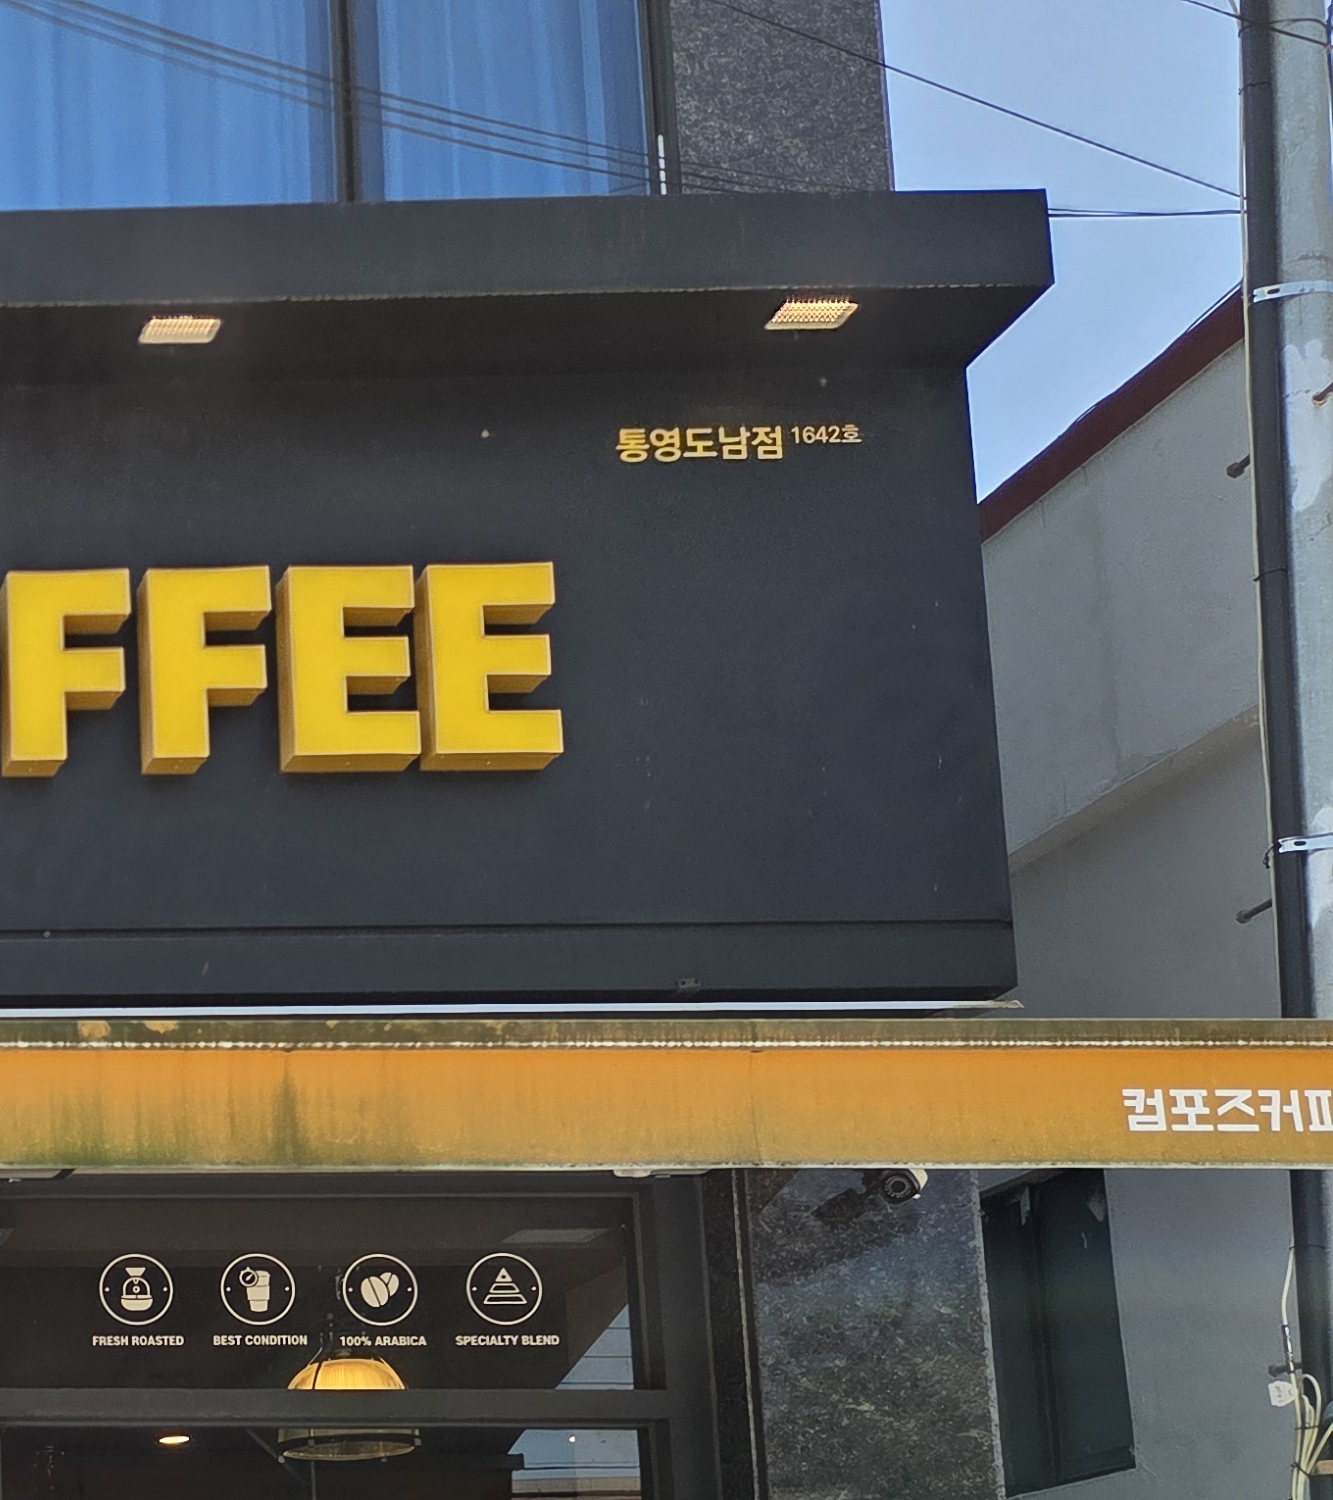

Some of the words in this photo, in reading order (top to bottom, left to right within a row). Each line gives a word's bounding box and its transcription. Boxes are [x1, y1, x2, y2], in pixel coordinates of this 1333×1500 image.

[616, 425, 783, 463] 통영도남점
[791, 424, 862, 444] 1642호
[92, 1335, 129, 1346] FRESH
[131, 1335, 184, 1346] ROASTED
[213, 1335, 242, 1346] BEST
[244, 1335, 308, 1346] CONDITION
[339, 1335, 372, 1346] 100%
[374, 1335, 427, 1346] ARABICA
[455, 1335, 519, 1346] SPECIALTY
[521, 1335, 560, 1346] BLEND
